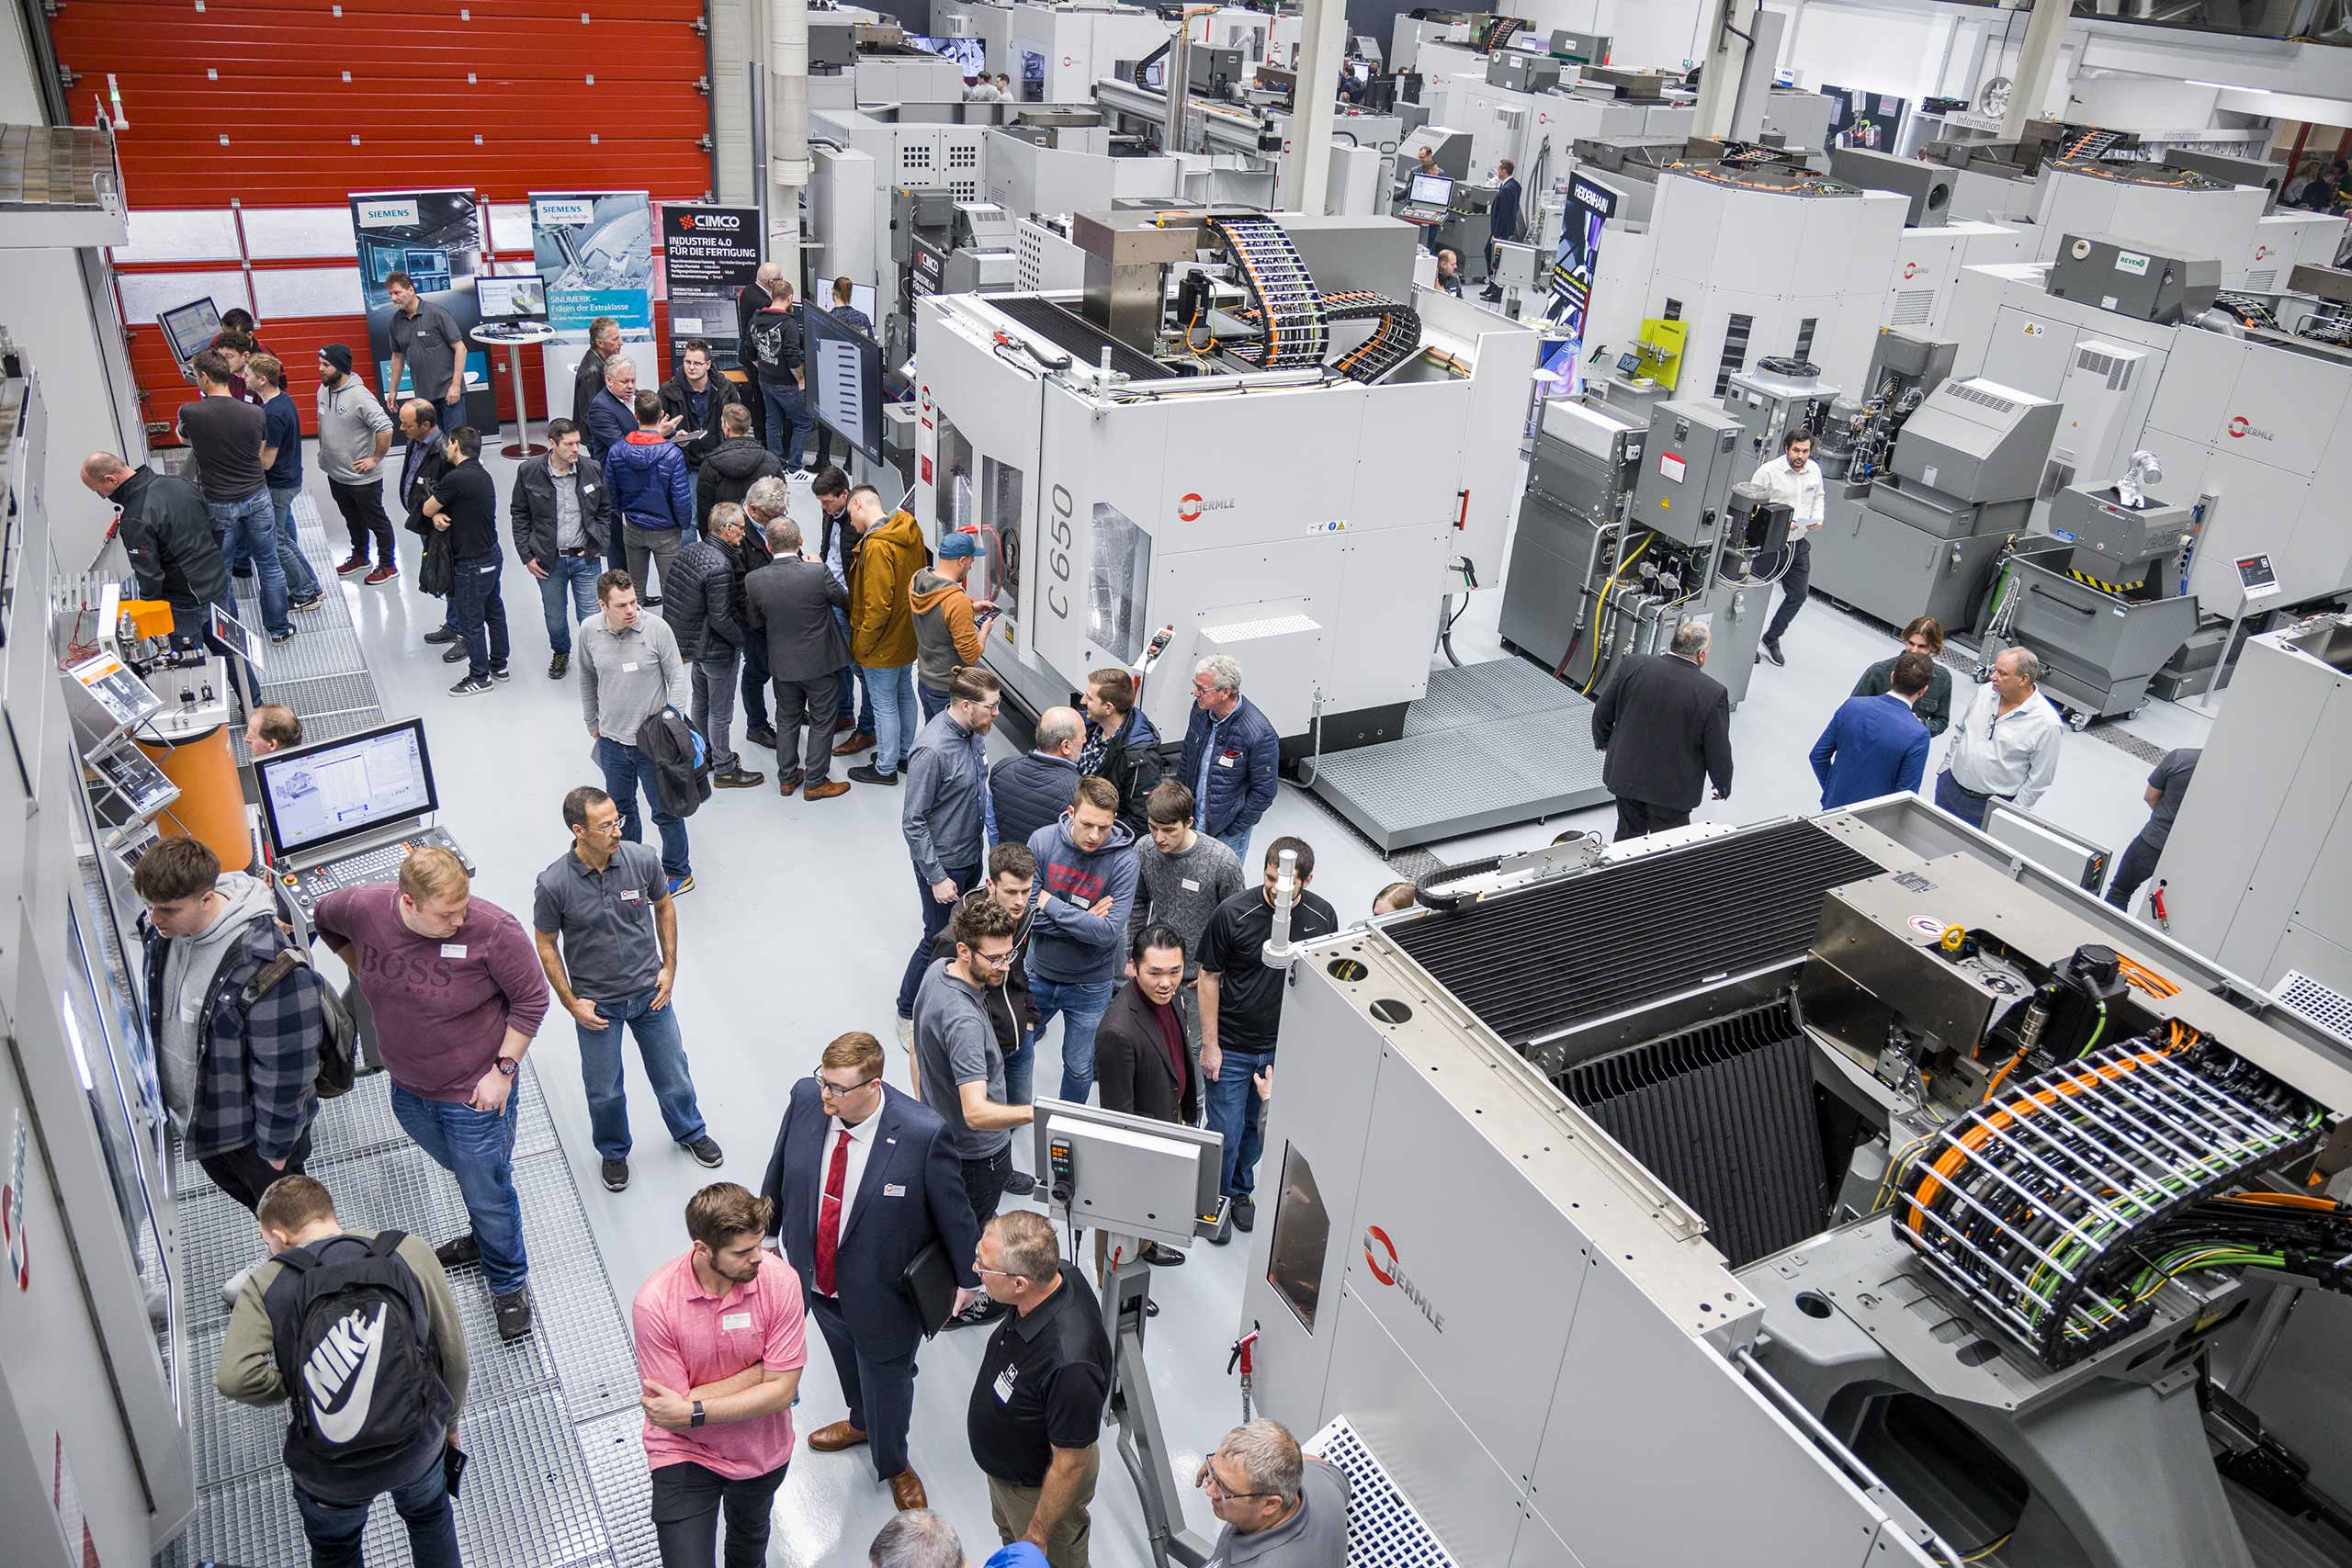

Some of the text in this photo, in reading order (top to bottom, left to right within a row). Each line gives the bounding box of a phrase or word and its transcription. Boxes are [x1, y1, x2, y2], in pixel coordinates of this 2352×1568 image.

[1956, 115, 2000, 131] Information
[1574, 184, 1610, 213] HEIDENHAIN
[368, 209, 410, 219] SIEMENS
[695, 215, 740, 227] CIMCO
[669, 237, 732, 247] INDUSTRIE 4.0
[670, 245, 756, 257] FÜR DIE FERTIGUNG
[922, 254, 938, 273] CIMCO
[551, 295, 591, 303] SINUMERIK
[551, 304, 575, 312] Fräsen
[590, 303, 629, 311] Extraklasse
[2242, 425, 2275, 441] HERMLE
[1195, 498, 1235, 512] HERMLE
[1048, 483, 1073, 619] C 650
[362, 944, 452, 987] BOSS
[1386, 1258, 1445, 1335] HERMLE
[304, 1309, 370, 1410] NIKE
